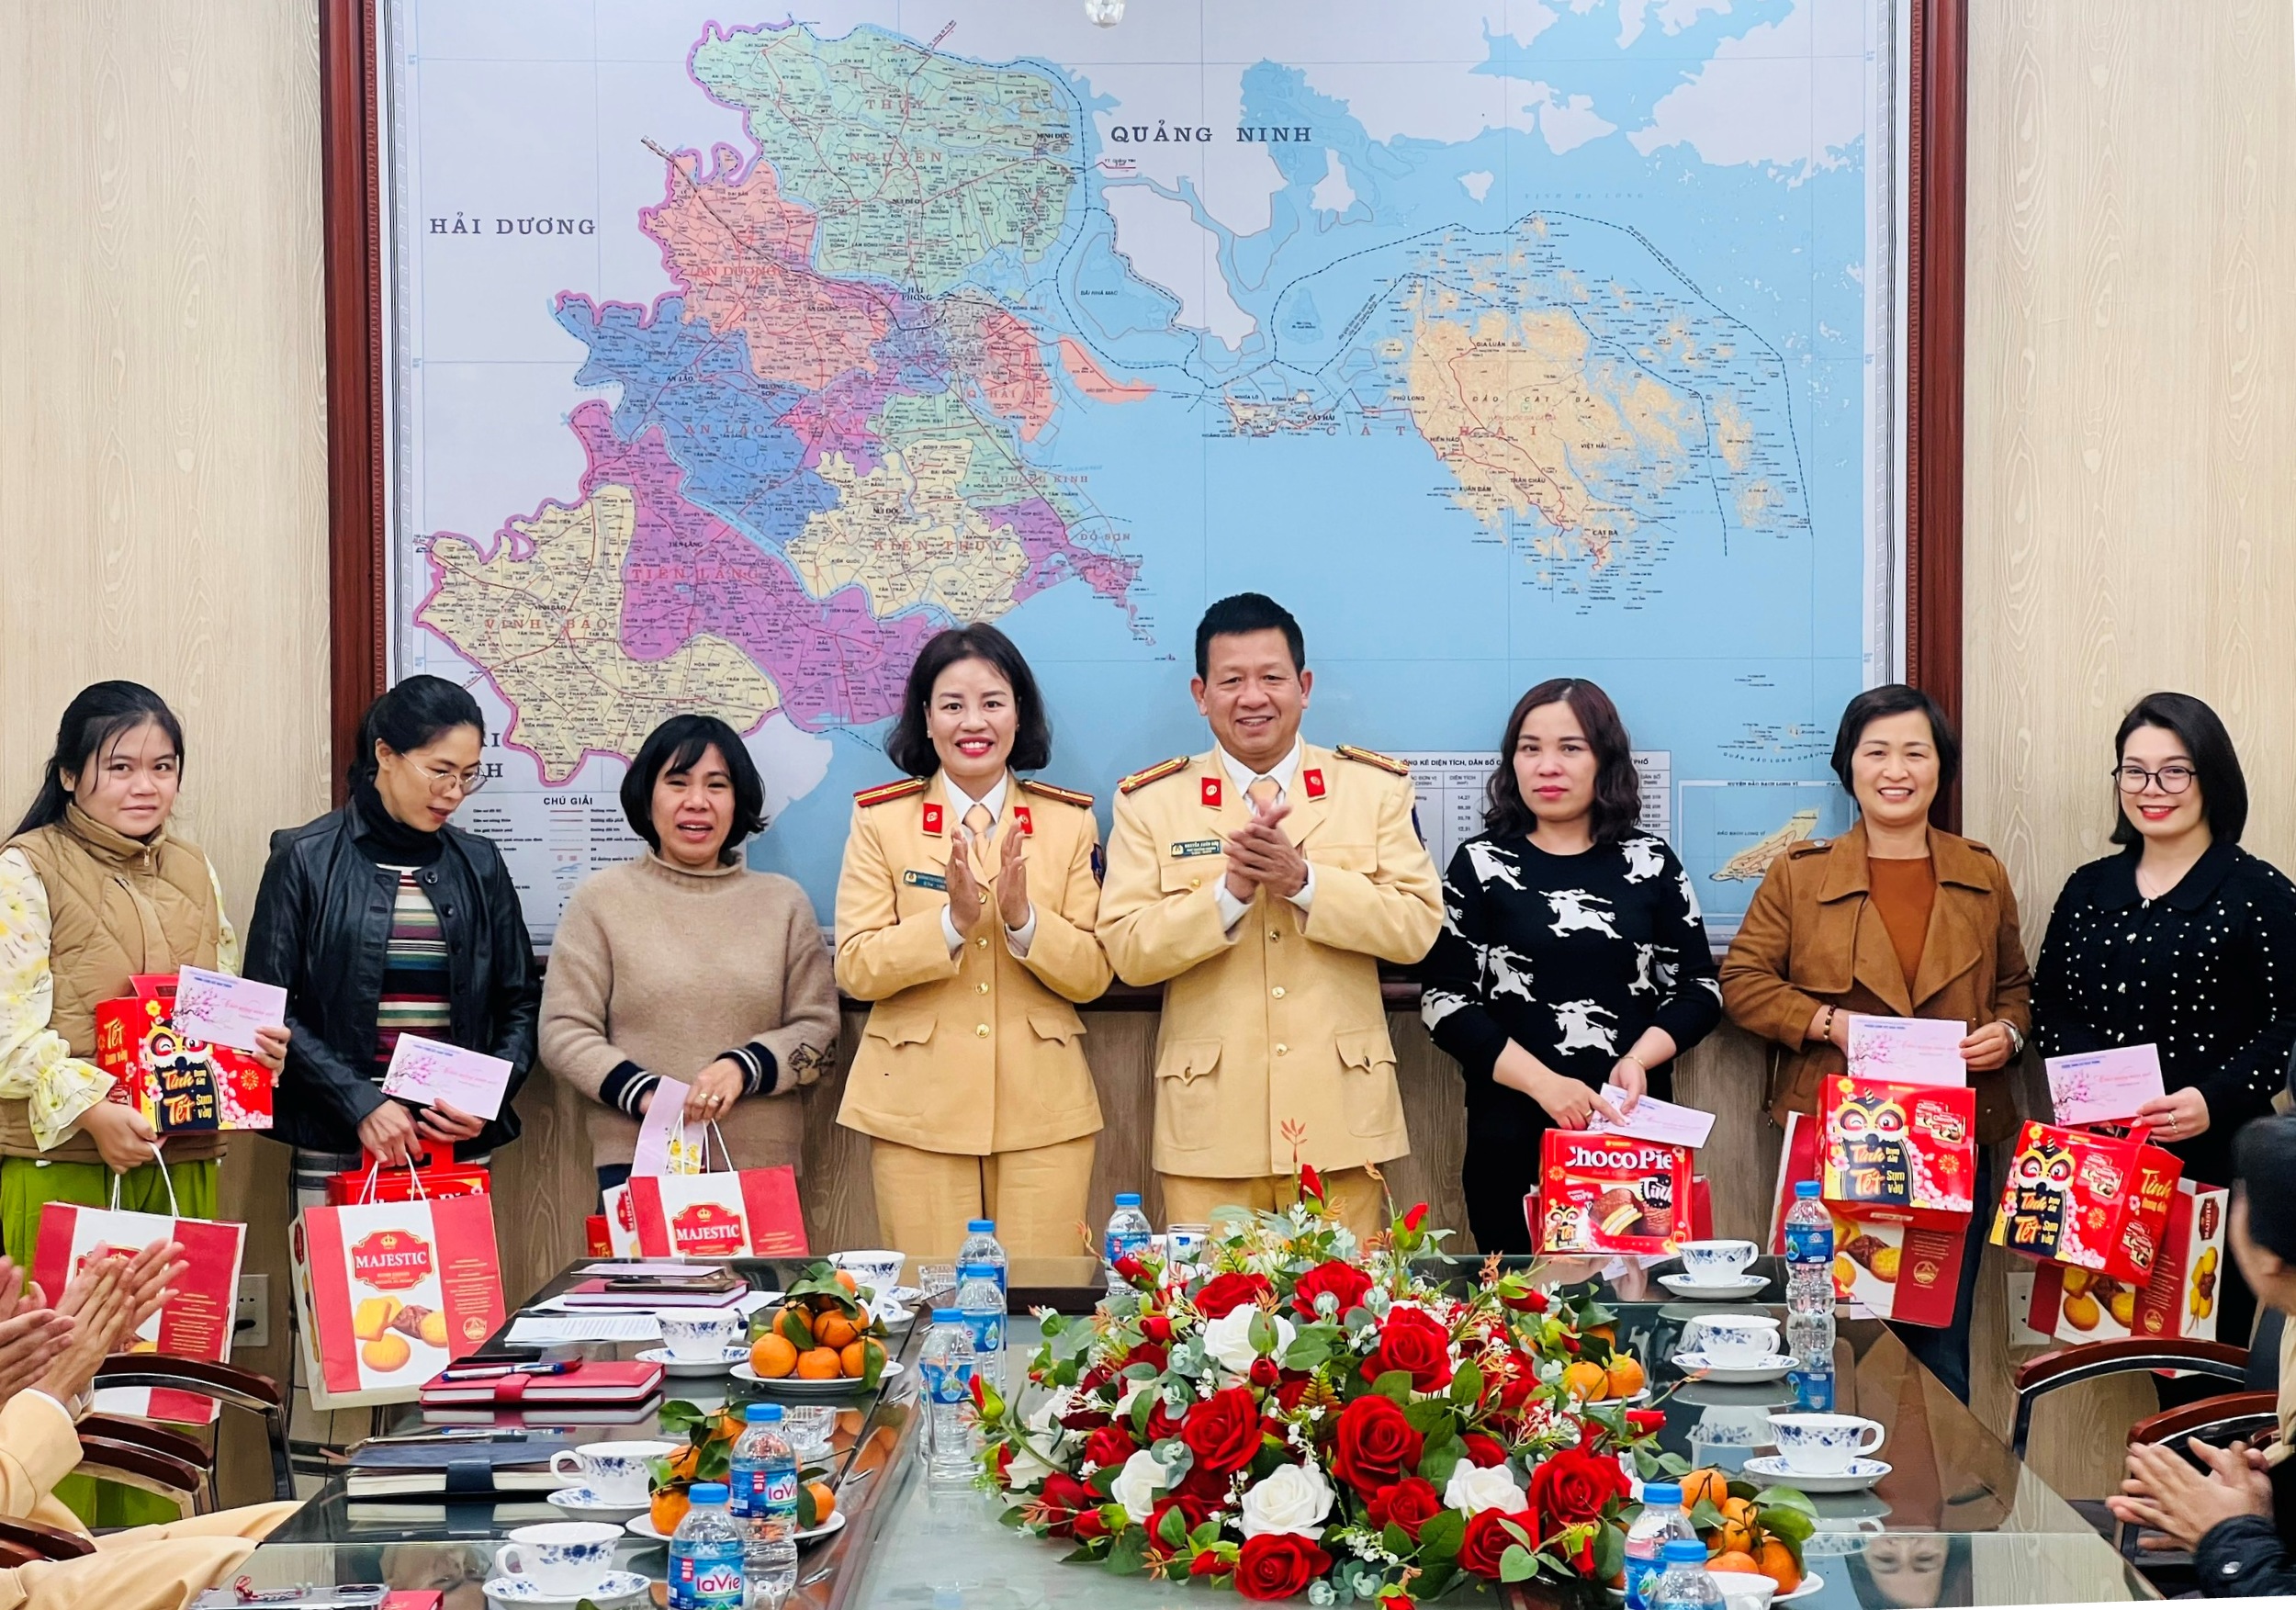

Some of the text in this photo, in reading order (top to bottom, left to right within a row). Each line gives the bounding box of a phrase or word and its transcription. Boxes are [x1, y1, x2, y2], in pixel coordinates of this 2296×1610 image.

[1110, 119, 1312, 143] QUẢNG NINH
[430, 211, 596, 235] HẢI DƯƠNG
[544, 794, 593, 805] CHÚ GIẢI
[104, 1017, 125, 1049] Tết
[163, 1093, 195, 1125] Tết
[1850, 1167, 1885, 1196] Tết
[1886, 1170, 1905, 1181] Sum
[676, 1224, 740, 1240] MAJESTIC
[2015, 1215, 2042, 1244] Tết
[355, 1251, 427, 1268] MAJESTIC
[696, 1572, 740, 1592] laVie
